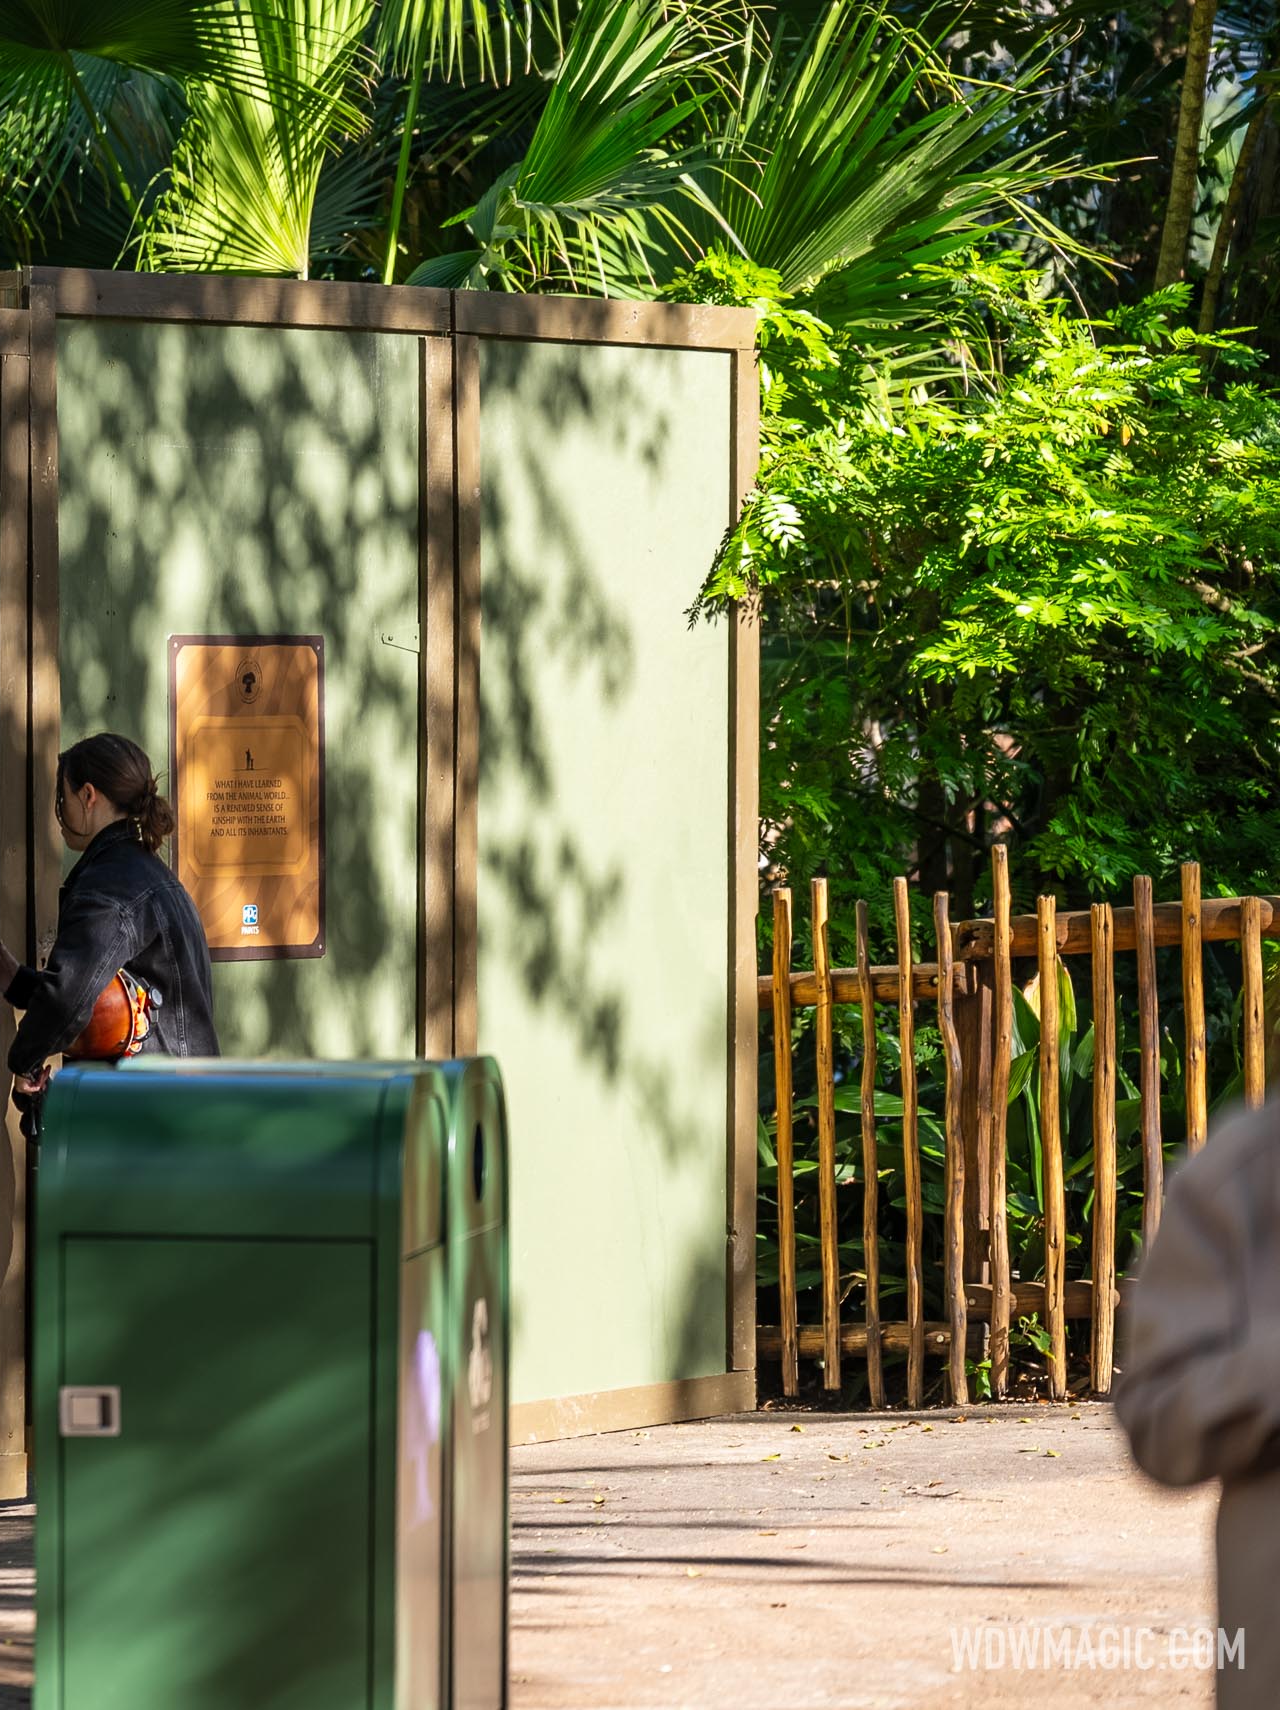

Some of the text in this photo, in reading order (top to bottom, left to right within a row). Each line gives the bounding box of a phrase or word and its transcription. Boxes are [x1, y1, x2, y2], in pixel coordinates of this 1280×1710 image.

[215, 780, 233, 789] WHAT
[238, 780, 254, 789] HAVE
[255, 779, 282, 788] LEARNED
[206, 792, 225, 801] FROM
[225, 792, 237, 800] THE
[238, 792, 263, 800] ANIMAL
[214, 803, 284, 813] IS A RENEWED SENSE OF
[212, 815, 286, 825] KINSHIP WITH THE EARTH
[210, 828, 225, 837] AND
[225, 828, 237, 837] ALL
[238, 828, 247, 836] ITS
